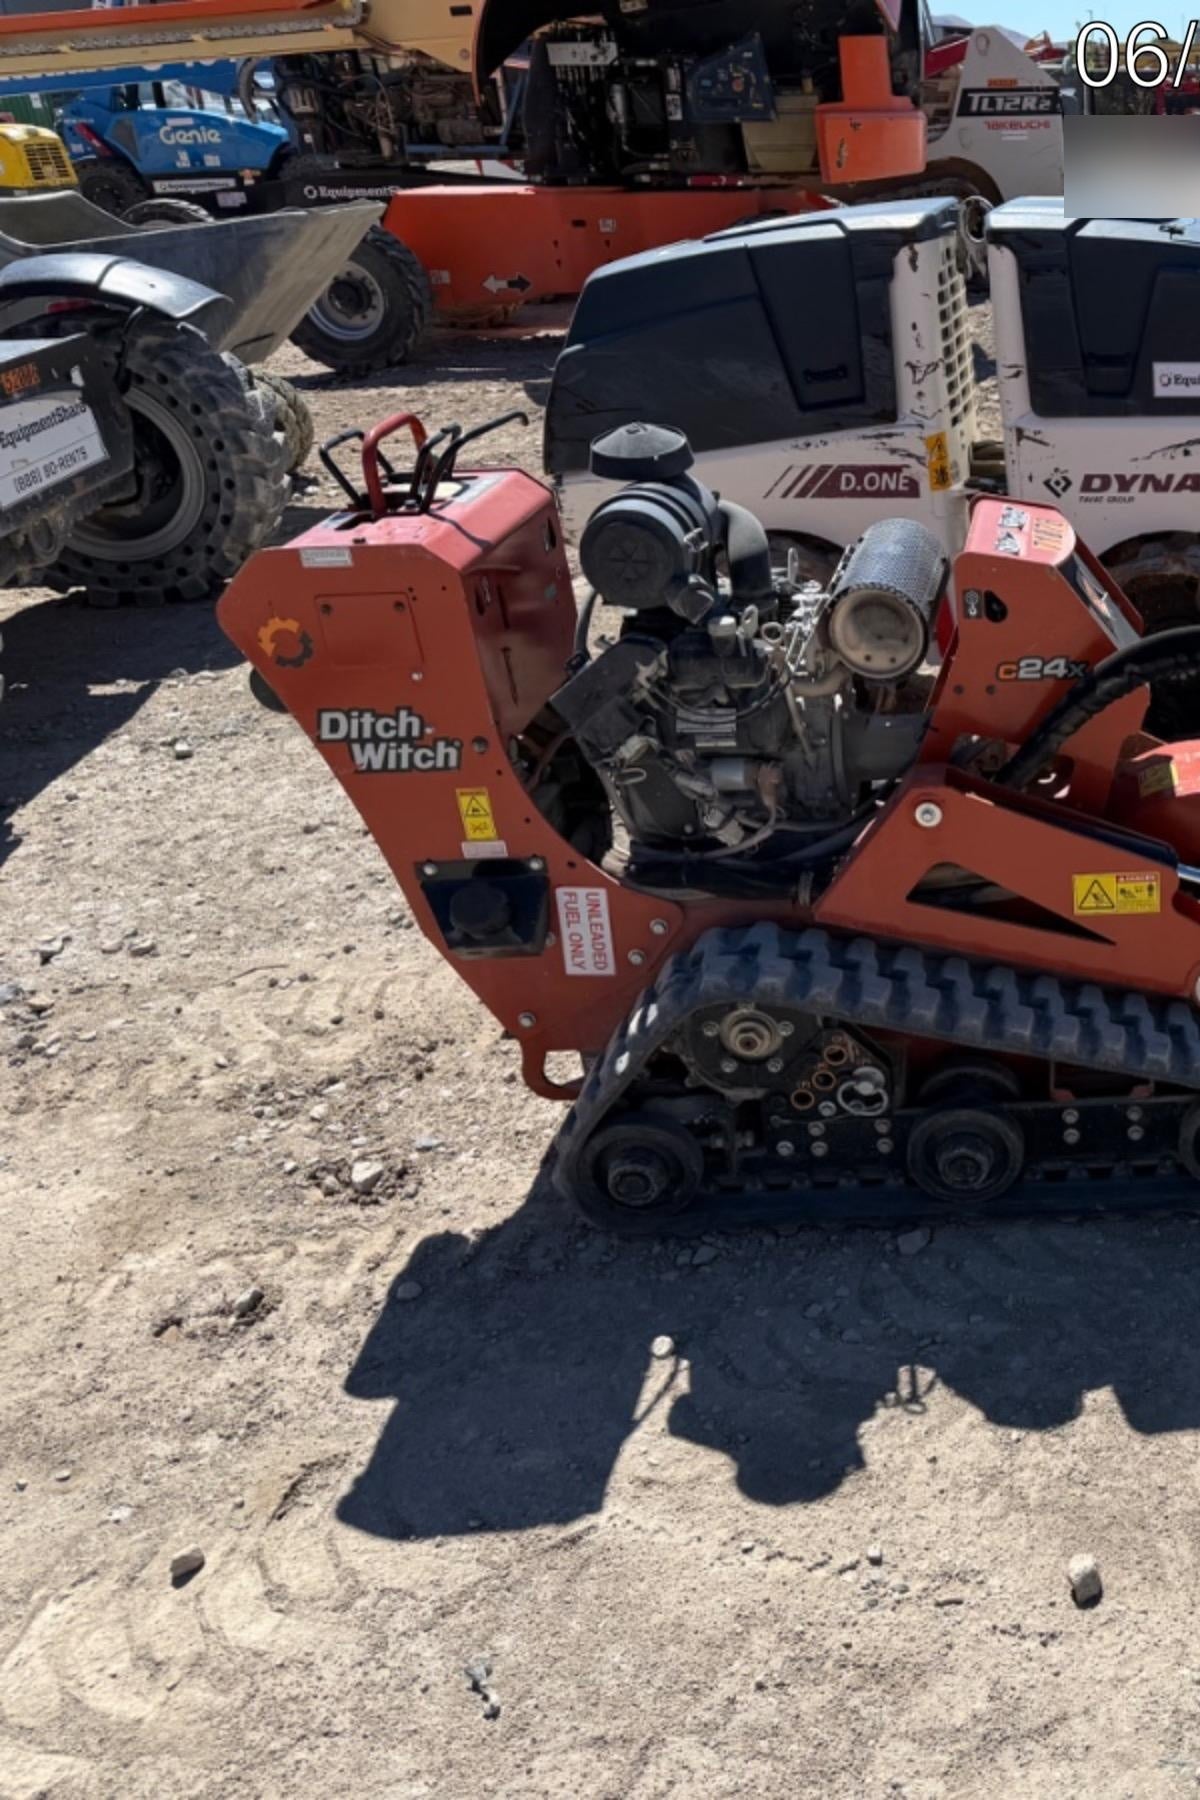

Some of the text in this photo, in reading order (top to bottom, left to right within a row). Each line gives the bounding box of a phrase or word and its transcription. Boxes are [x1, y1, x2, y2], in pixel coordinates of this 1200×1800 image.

[159, 126, 222, 145] Genie
[13, 467, 43, 493] (888)
[840, 472, 910, 491] D.ONE
[318, 708, 422, 741] Ditch
[350, 739, 460, 772] Witch
[563, 891, 588, 970] FUEL ONLY
[585, 891, 609, 971] UNLEADED
